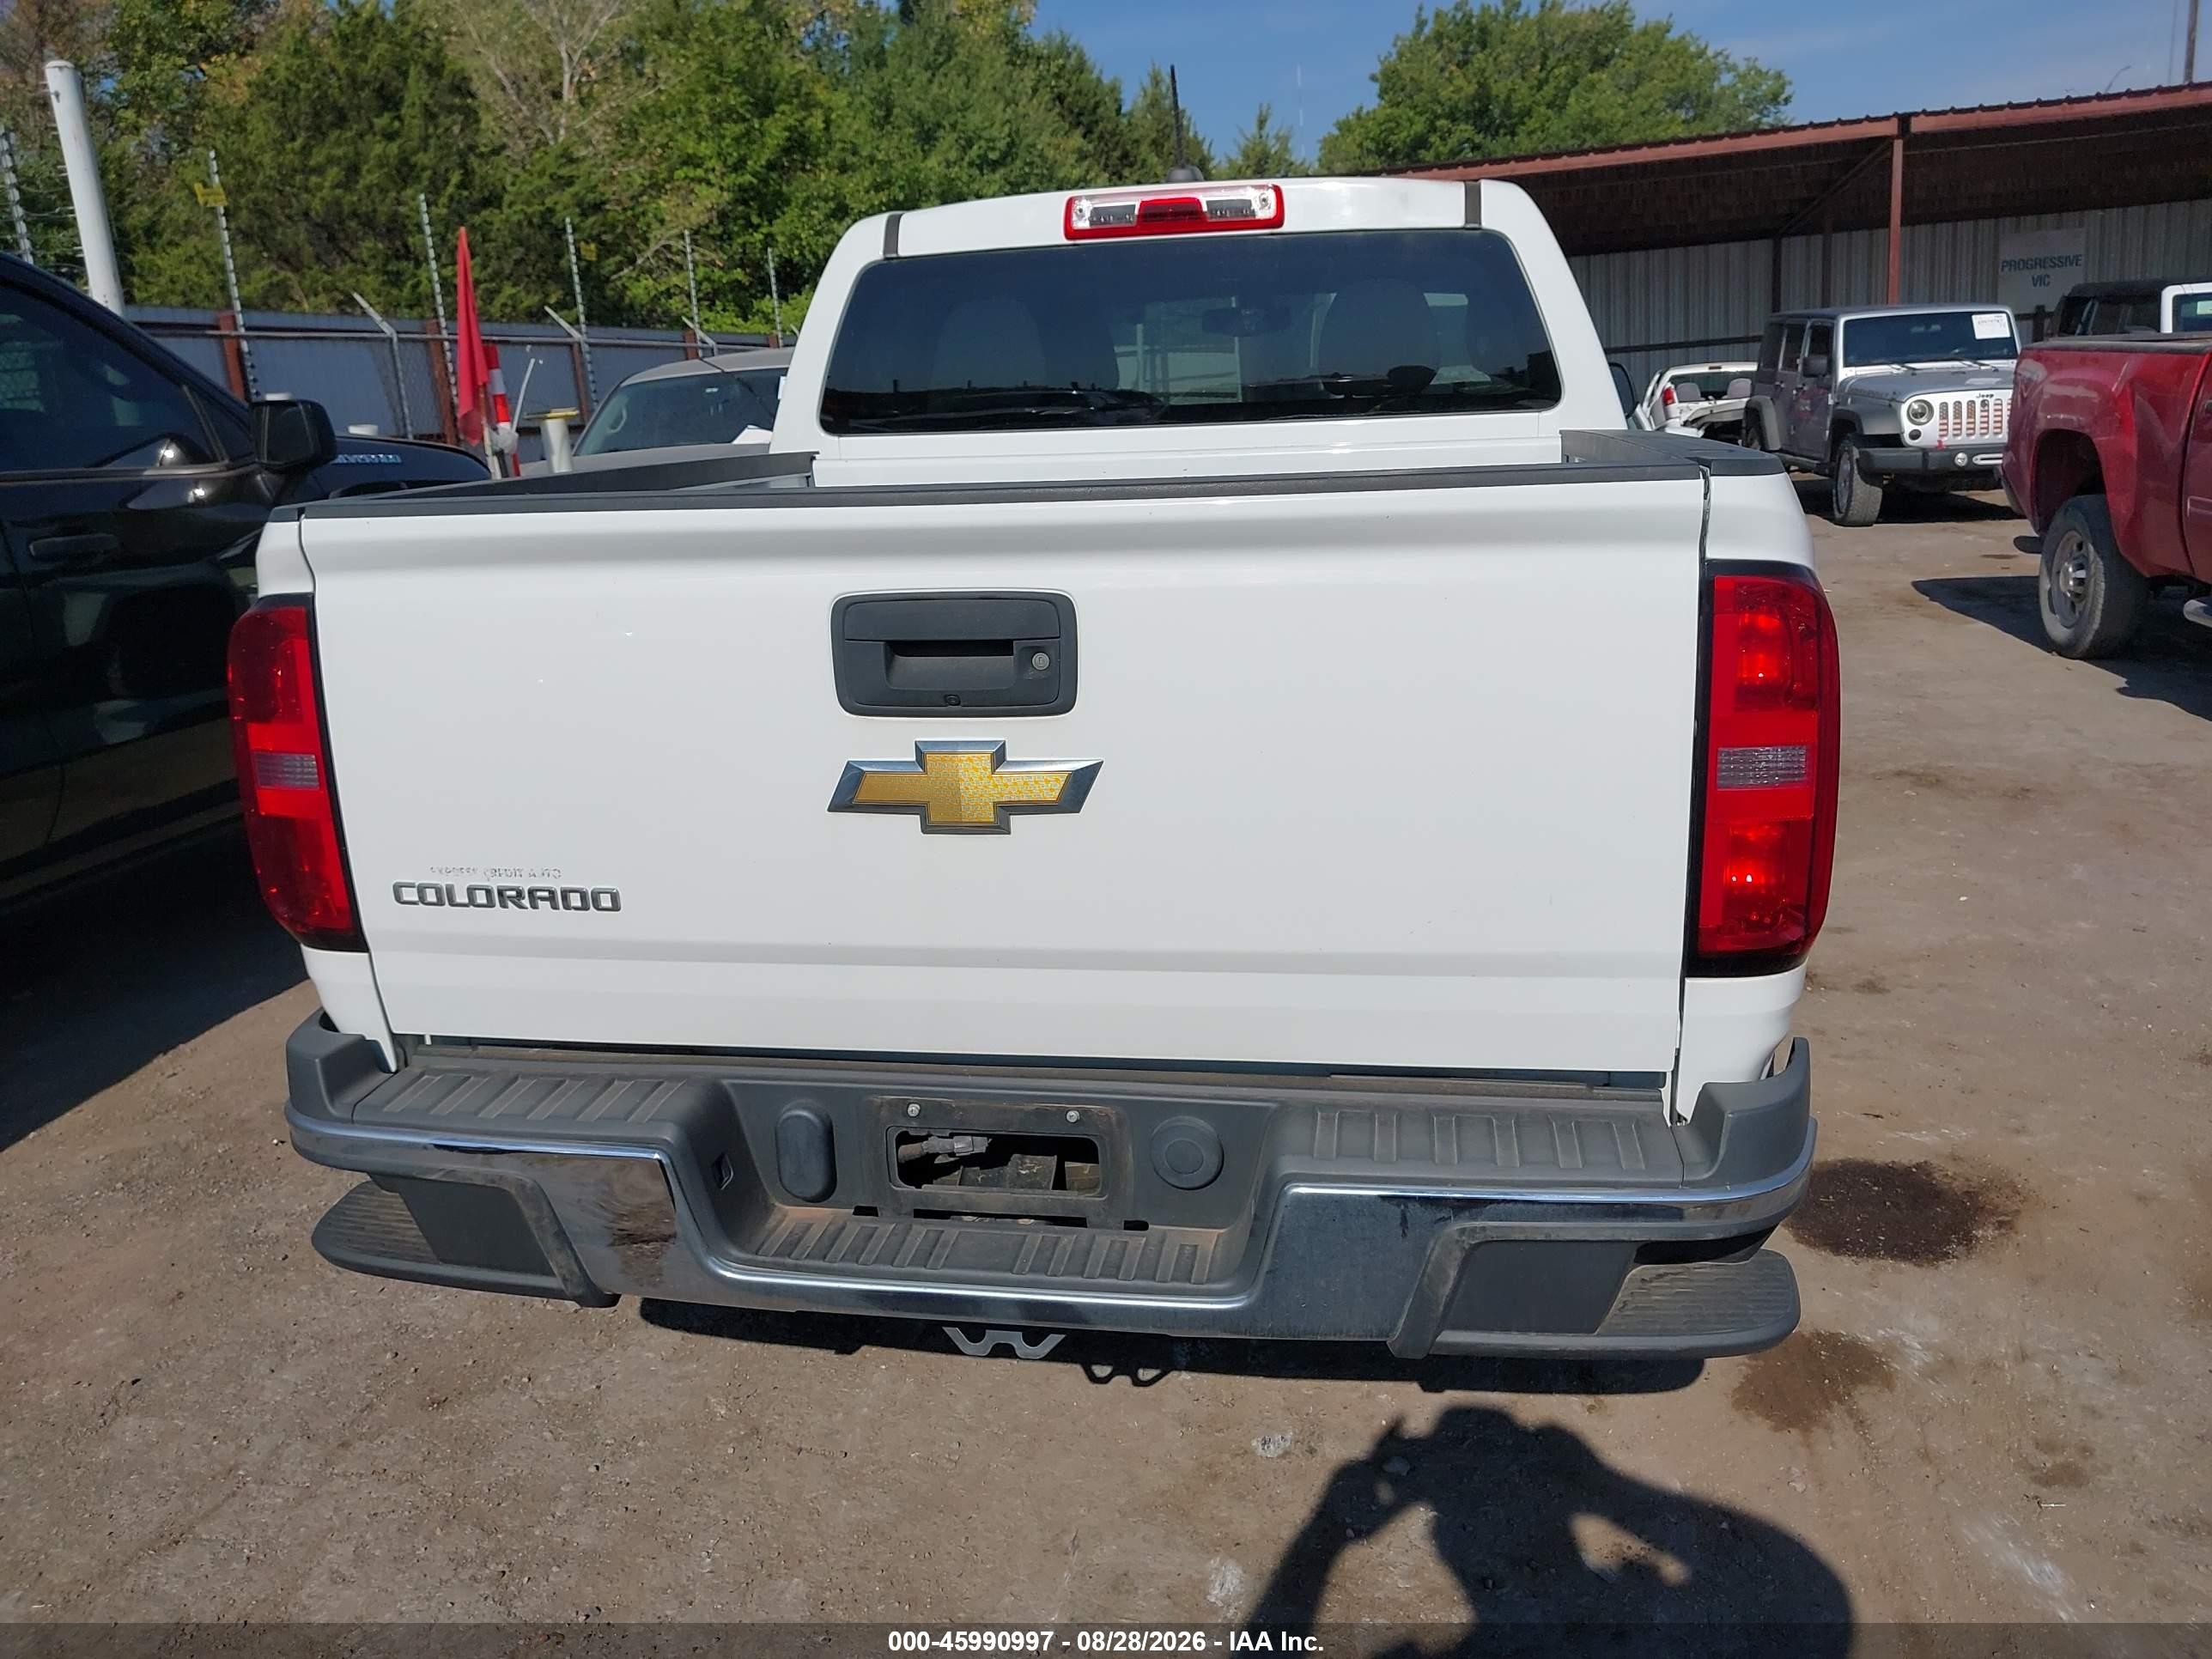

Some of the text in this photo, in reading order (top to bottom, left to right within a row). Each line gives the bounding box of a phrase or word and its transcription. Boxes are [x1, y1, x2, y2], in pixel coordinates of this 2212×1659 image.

[2001, 254, 2082, 272] PROGRESSIVE
[2032, 274, 2051, 288] VIC
[392, 882, 622, 912] COLORADO
